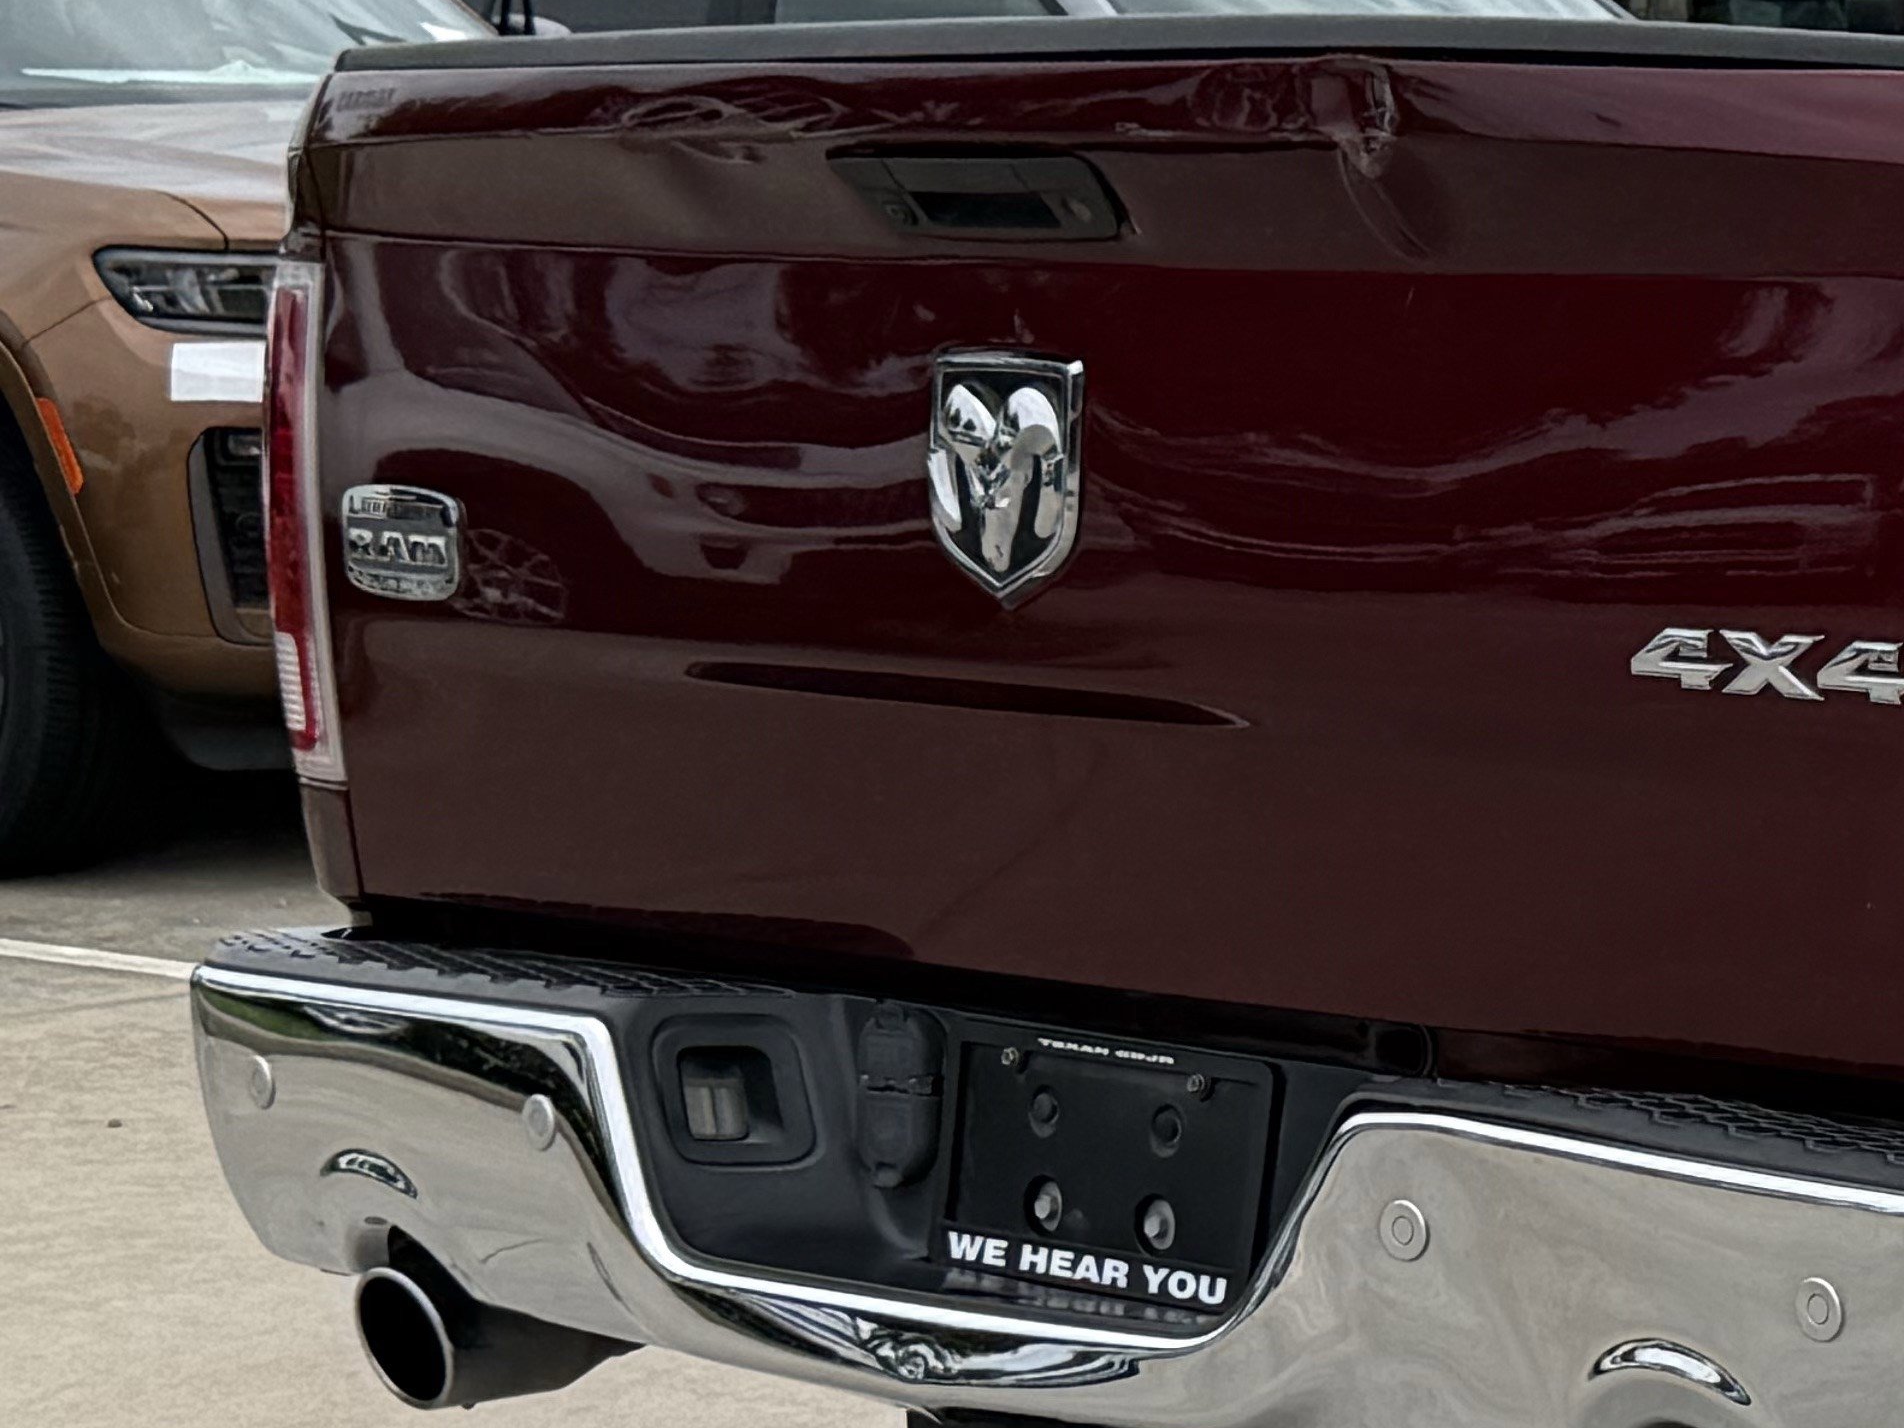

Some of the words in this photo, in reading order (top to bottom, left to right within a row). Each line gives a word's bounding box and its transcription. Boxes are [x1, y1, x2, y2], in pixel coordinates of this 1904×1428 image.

[948, 1231, 1008, 1267] WE
[1018, 1244, 1129, 1288] HEAR
[1143, 1264, 1227, 1304] YOU
